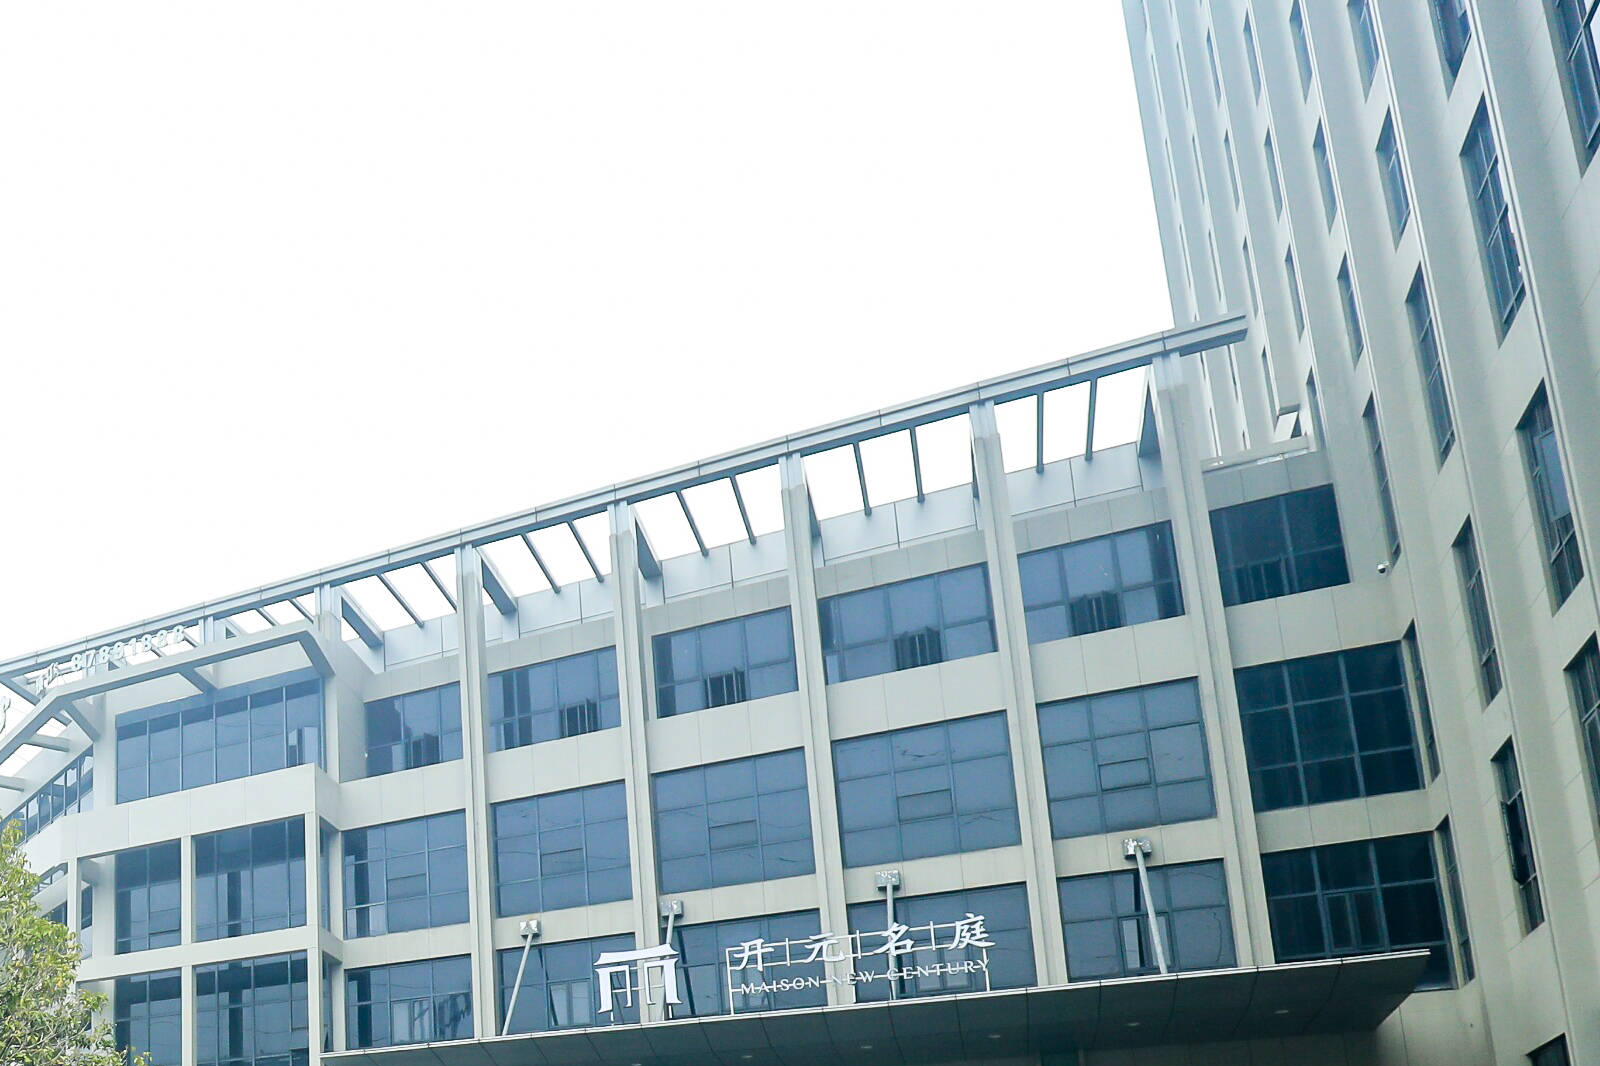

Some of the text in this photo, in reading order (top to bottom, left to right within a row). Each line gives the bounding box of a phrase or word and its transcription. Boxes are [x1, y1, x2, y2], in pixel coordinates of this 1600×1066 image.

[733, 912, 997, 972] 开元名庭
[741, 958, 991, 995] MAISON NEW CENTURY
